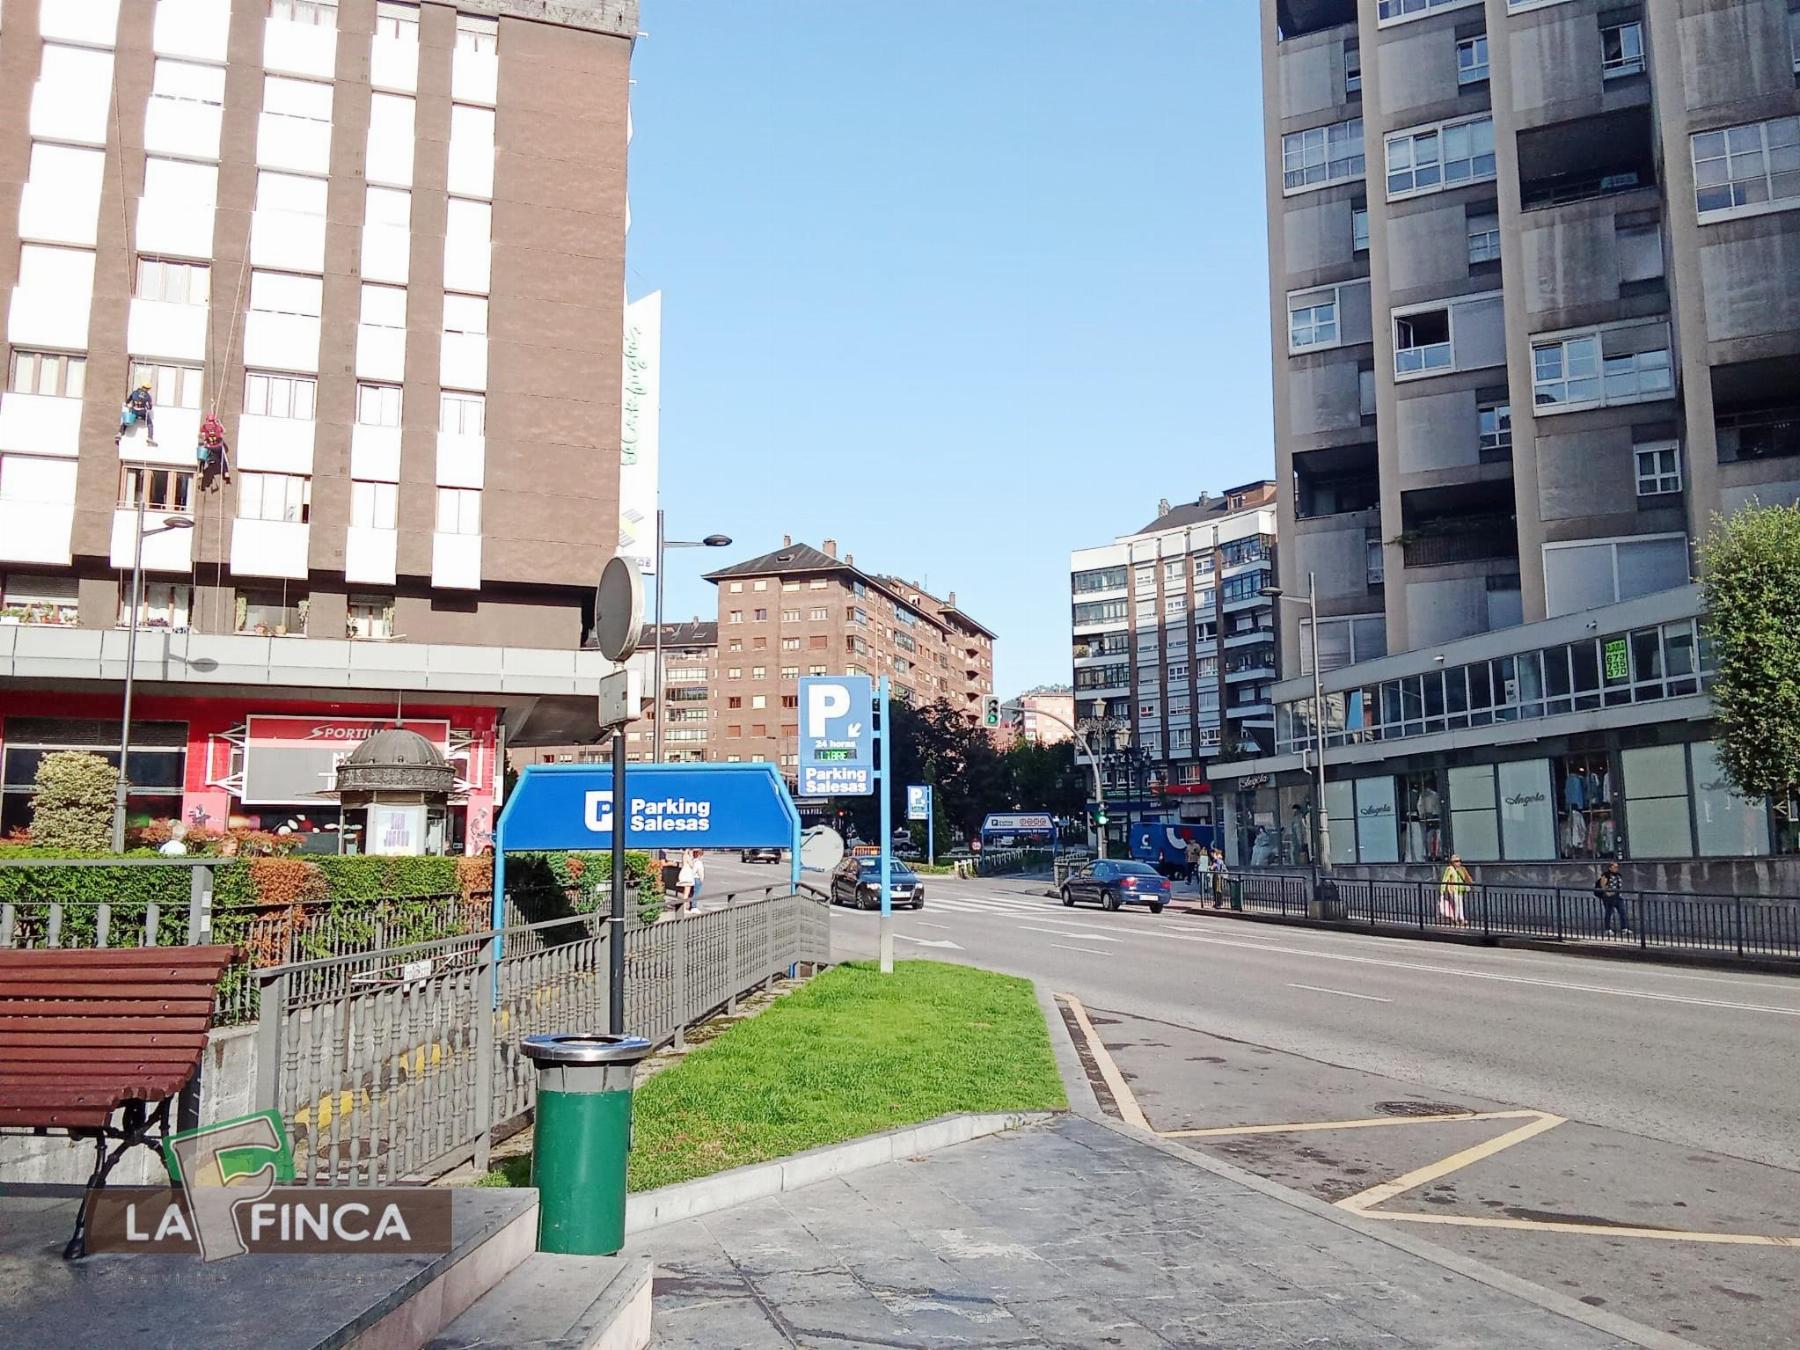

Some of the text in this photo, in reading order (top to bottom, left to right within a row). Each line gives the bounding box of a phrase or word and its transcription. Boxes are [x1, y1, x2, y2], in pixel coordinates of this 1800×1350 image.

[1607, 668, 1627, 677] 370
[808, 684, 851, 738] P
[304, 724, 384, 739] SPORTIU
[815, 739, 857, 748] 24 horas
[820, 750, 848, 761] LIBRE
[806, 767, 867, 783] Parking
[806, 780, 867, 793] Salesas
[910, 788, 923, 804] P
[631, 798, 711, 818] Parking
[630, 816, 710, 831] Salesas
